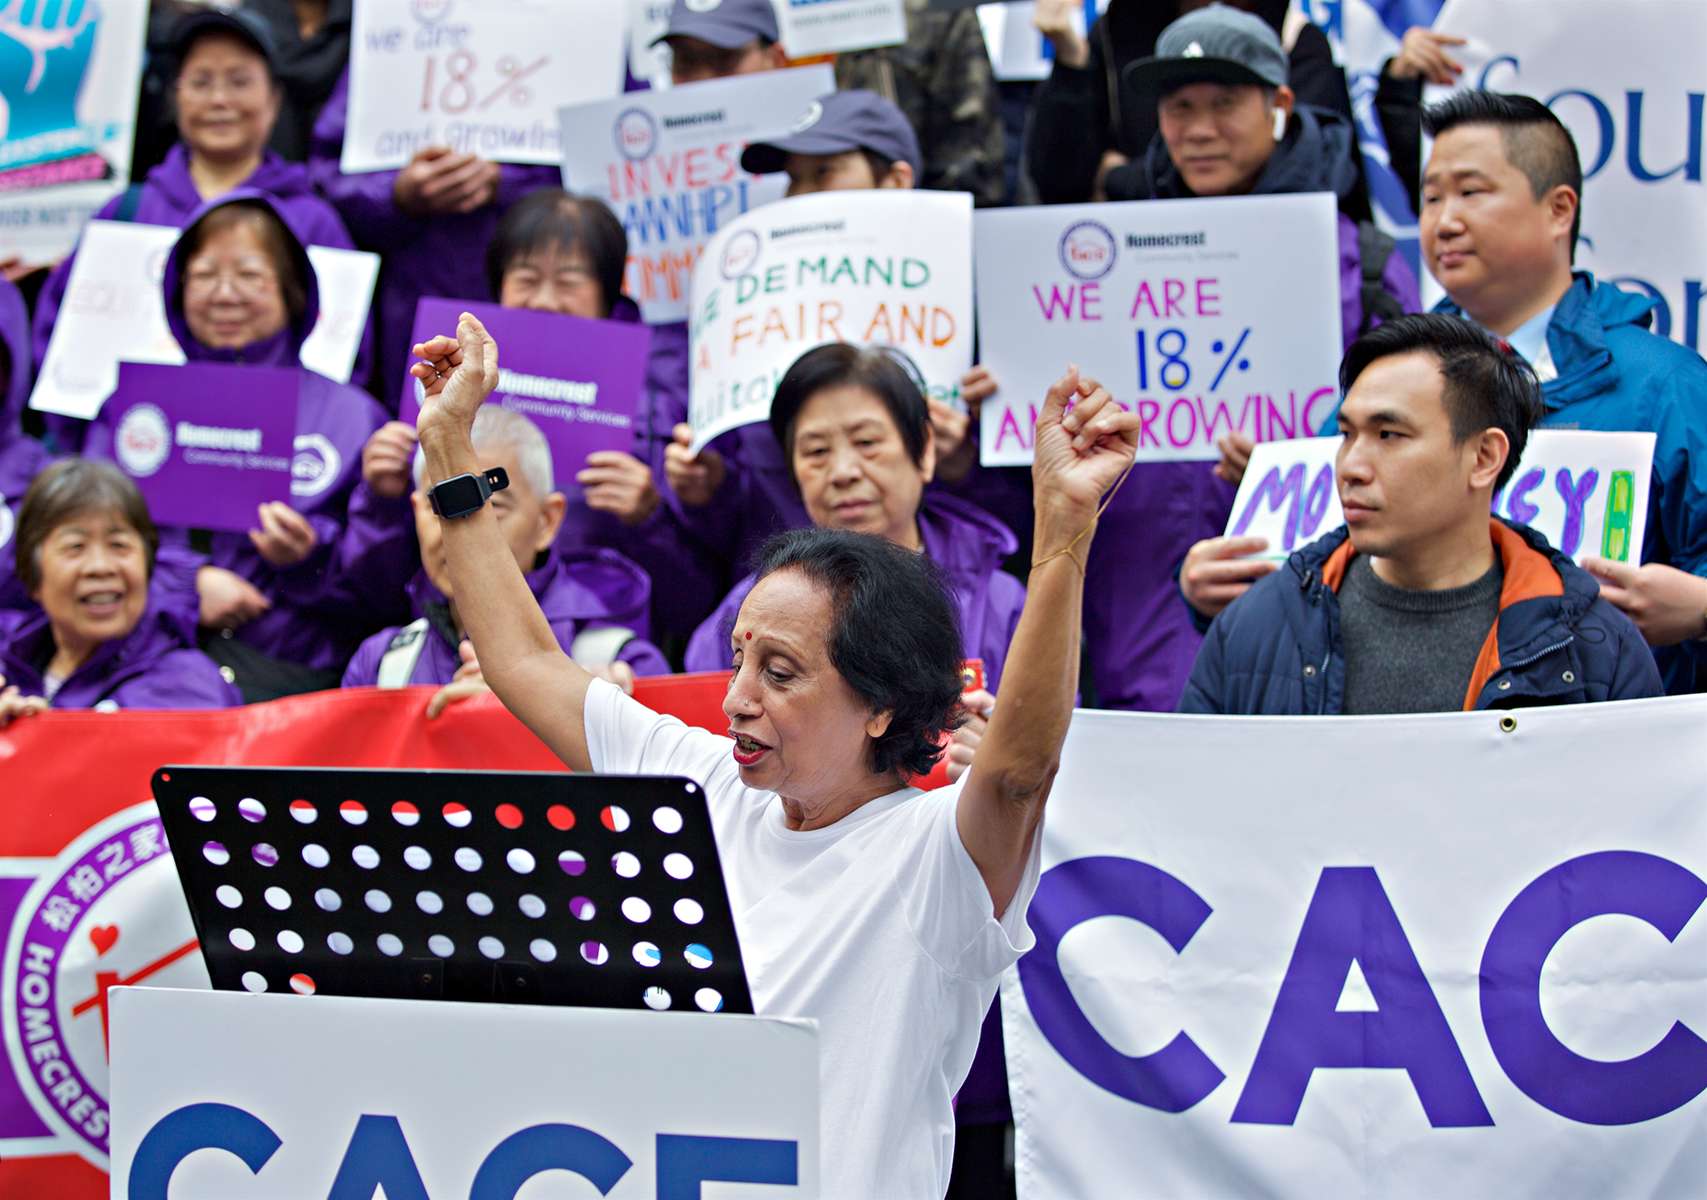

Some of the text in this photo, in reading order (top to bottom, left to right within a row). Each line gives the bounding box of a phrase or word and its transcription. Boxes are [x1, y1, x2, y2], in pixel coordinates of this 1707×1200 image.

[443, 121, 560, 152] growin
[733, 256, 931, 305] DEMAND
[1032, 277, 1222, 321] WE ARE
[731, 300, 844, 357] FAIR
[863, 303, 957, 347] AND
[1118, 387, 1335, 449] ROWING
[20, 940, 111, 1150] HOMECRES
